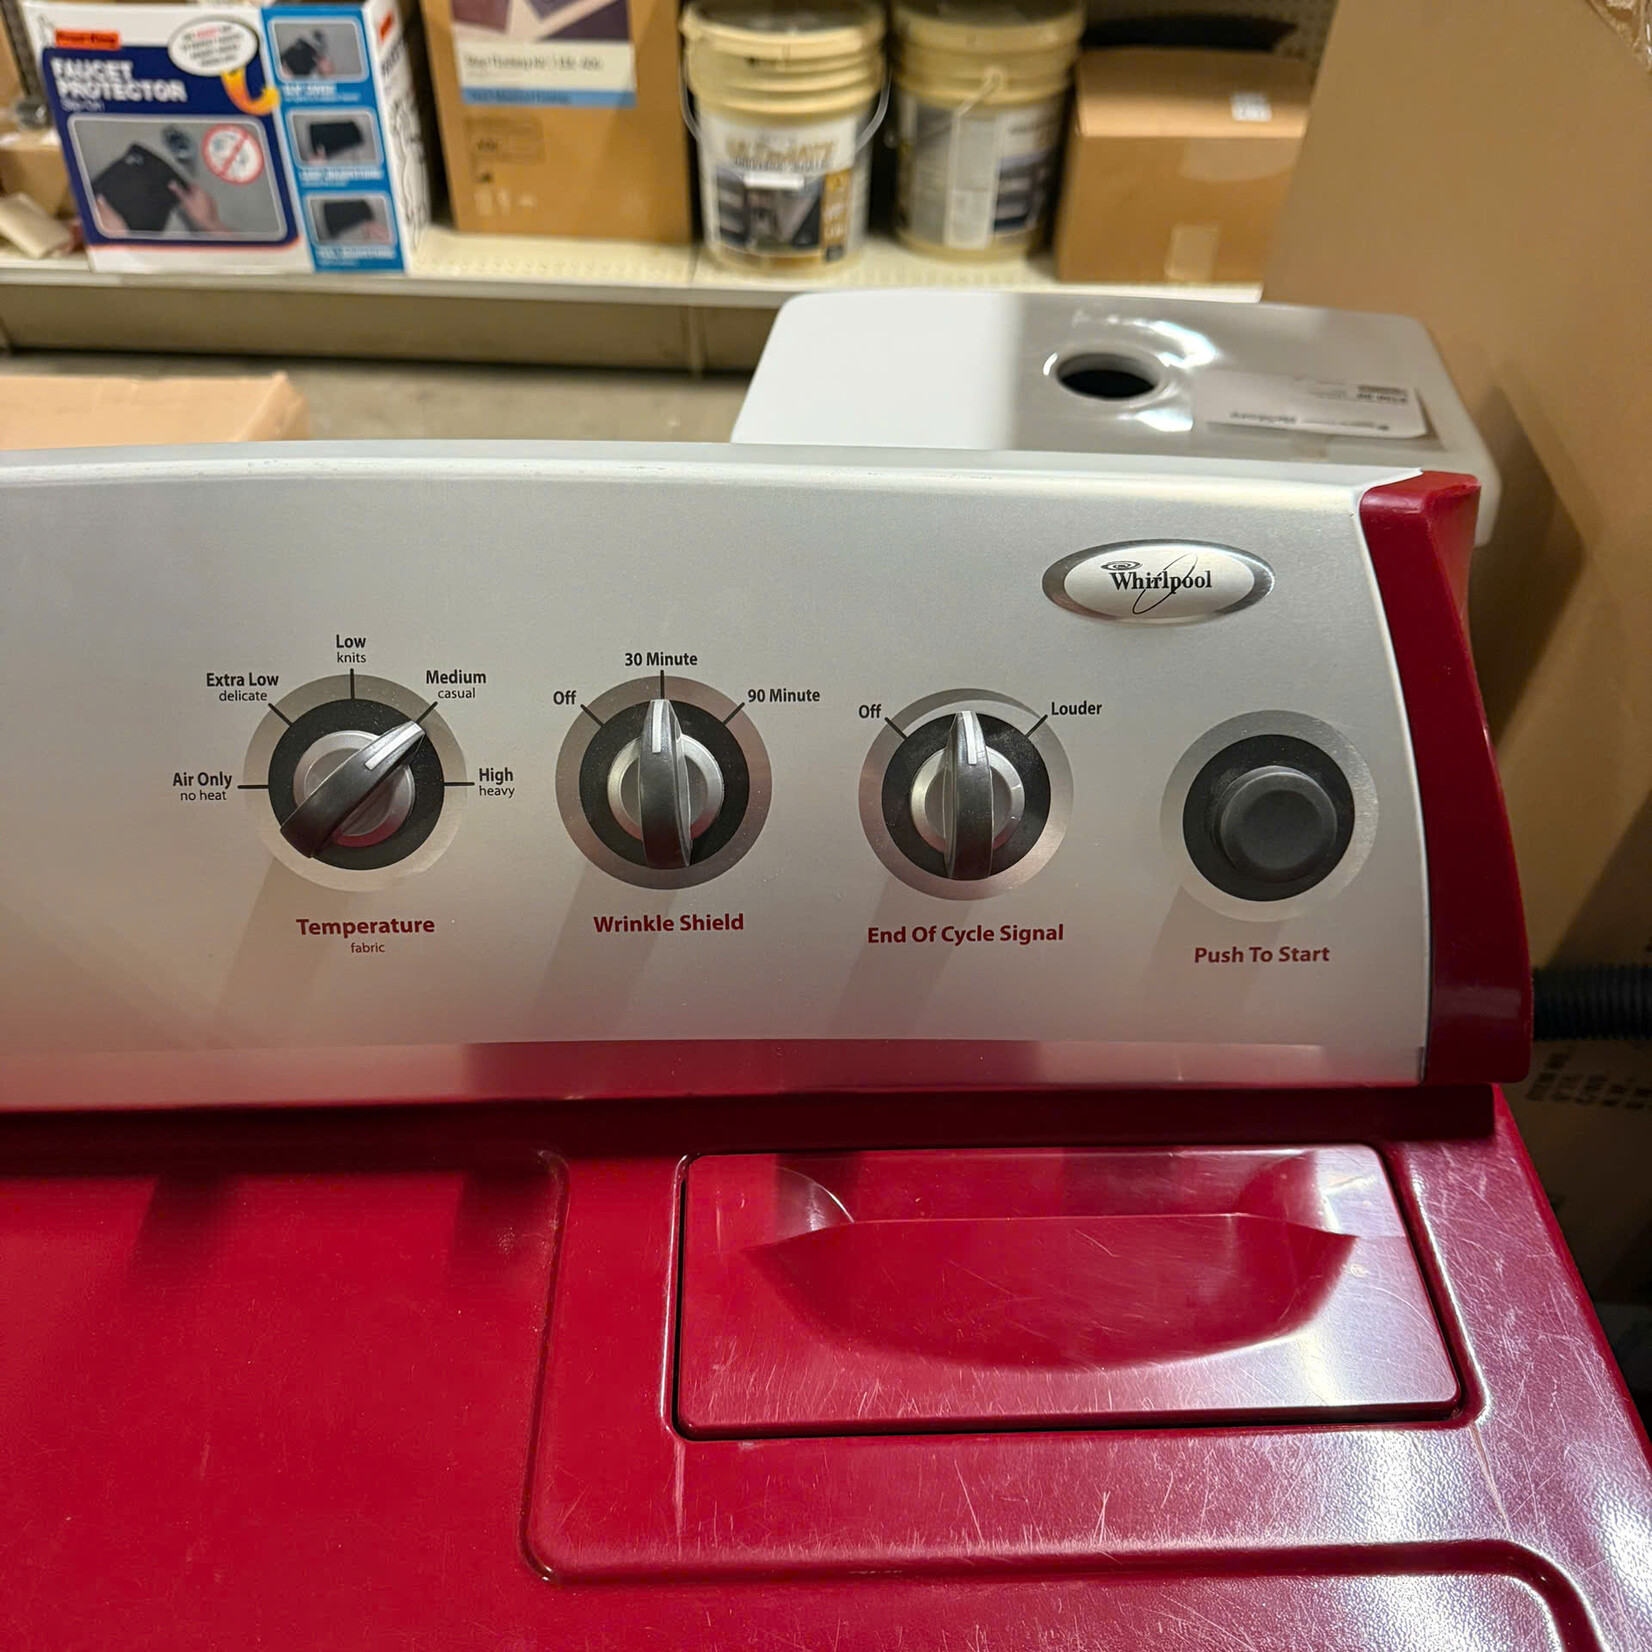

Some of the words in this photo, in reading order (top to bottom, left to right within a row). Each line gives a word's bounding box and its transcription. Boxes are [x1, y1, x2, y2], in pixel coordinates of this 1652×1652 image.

[51, 58, 133, 80] FAUCET
[56, 80, 188, 102] PROTECTOR
[1109, 571, 1212, 594] Whirlpool
[335, 633, 367, 649] Low
[336, 651, 367, 664] knits
[624, 652, 643, 667] 30
[646, 651, 698, 667] Minute
[206, 672, 245, 687] Extra
[248, 671, 280, 687] Low
[425, 668, 487, 685] Medium
[219, 690, 268, 702] delicate
[437, 687, 476, 700] casual
[552, 689, 577, 706] Off
[747, 688, 766, 703] 90
[769, 687, 821, 703] Minute
[858, 703, 882, 719] Off
[1051, 699, 1103, 716] Louder
[172, 771, 195, 787] Air
[197, 771, 232, 789] Only
[478, 767, 514, 786] High
[181, 792, 196, 801] no
[199, 788, 227, 801] heat
[478, 785, 516, 799] heavy
[295, 918, 436, 938] Temperature
[593, 914, 675, 933] Wrinkle
[679, 912, 744, 932] Shield
[867, 925, 907, 944] End
[911, 925, 938, 943] Of
[941, 924, 995, 947] Cycle
[999, 923, 1064, 946] Signal
[350, 942, 386, 954] fabric
[1194, 946, 1244, 964] Push
[1248, 946, 1274, 963] To
[1278, 945, 1331, 963] Start
